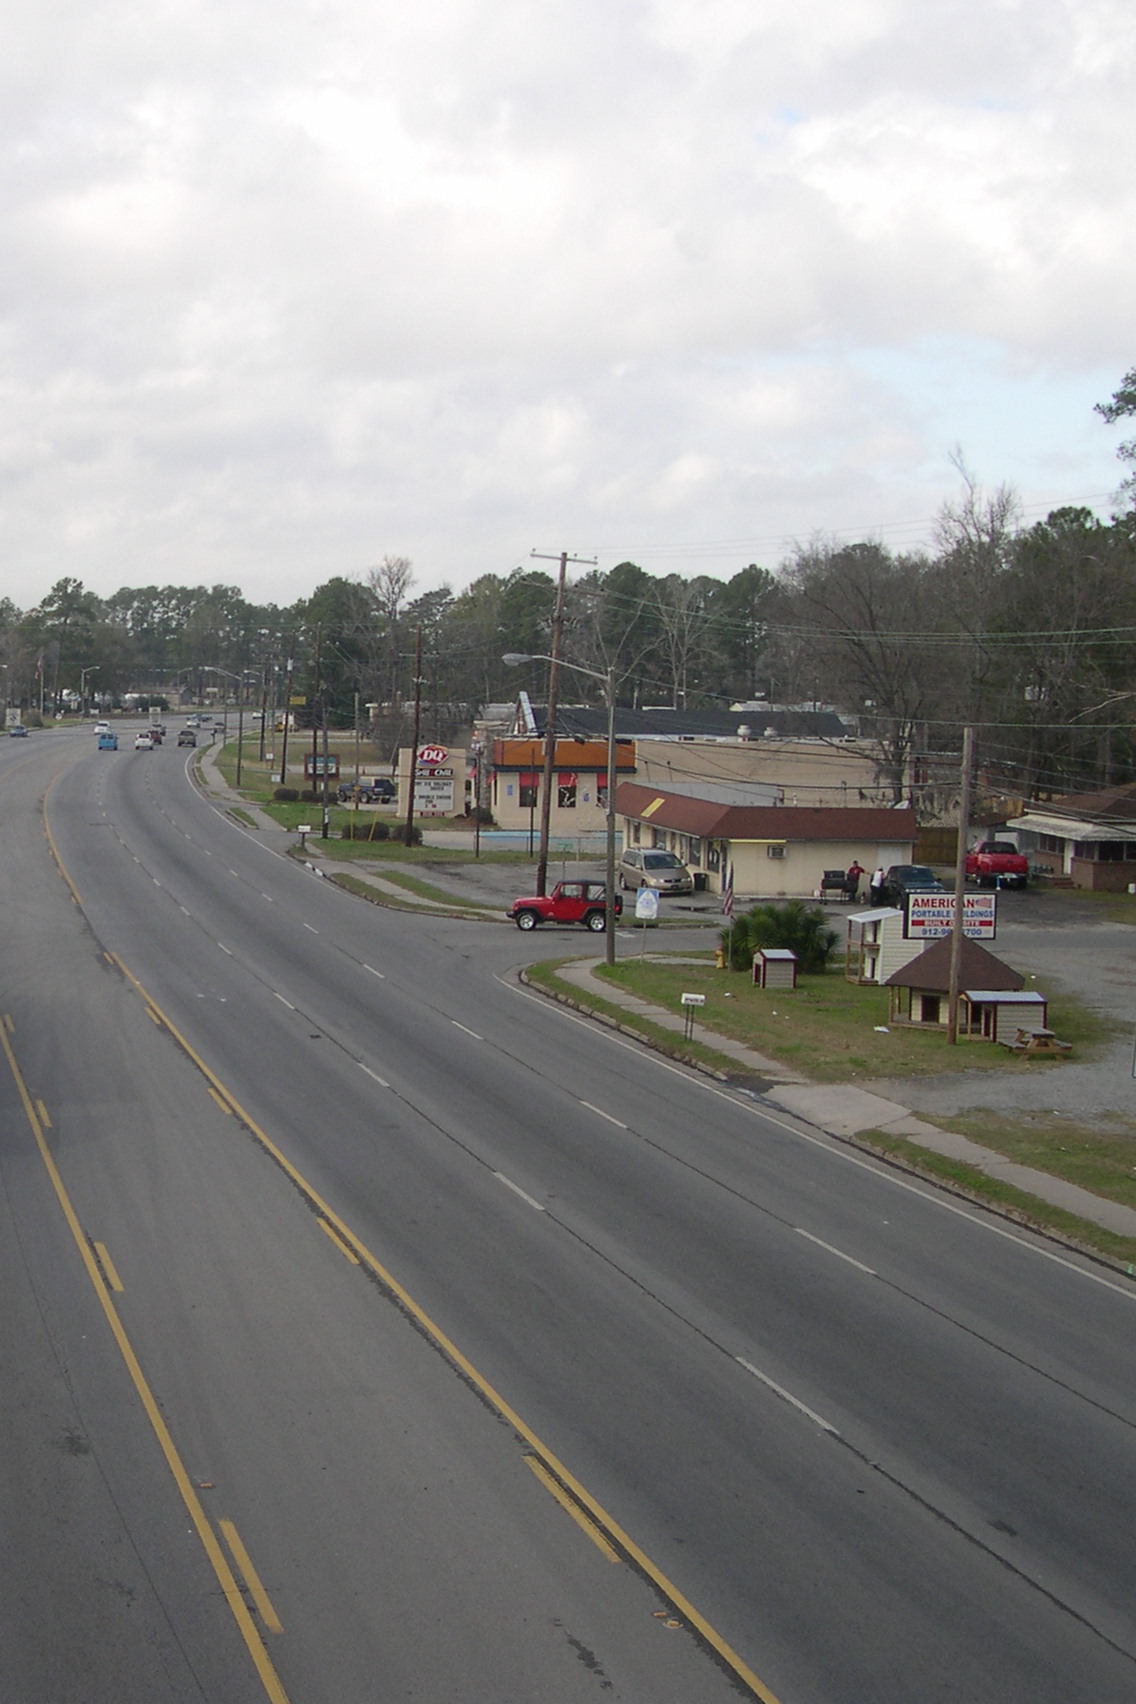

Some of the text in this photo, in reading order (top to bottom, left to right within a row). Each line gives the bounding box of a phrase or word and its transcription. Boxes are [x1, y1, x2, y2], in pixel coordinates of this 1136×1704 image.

[423, 750, 444, 762] DQ
[912, 898, 975, 908] AMERICN
[911, 910, 951, 918] PORTABLE
